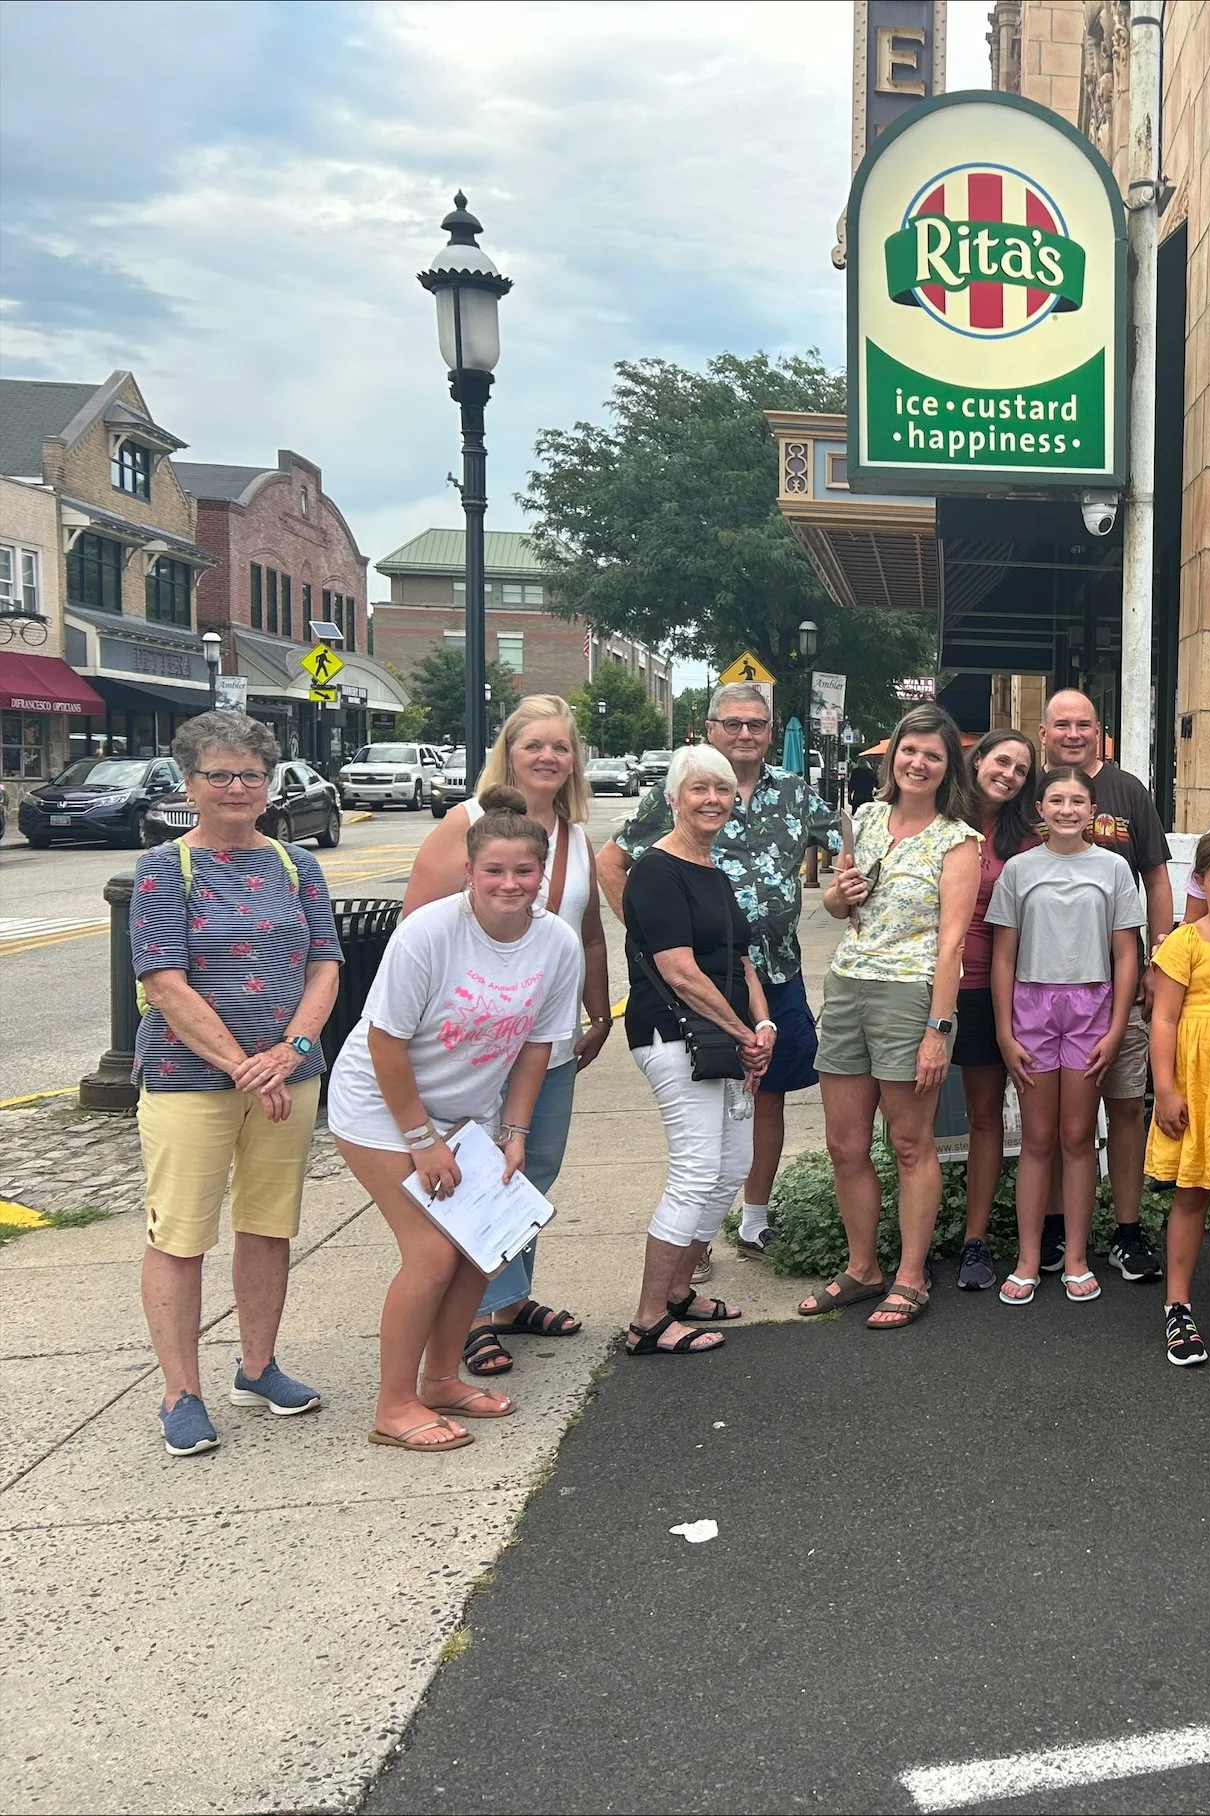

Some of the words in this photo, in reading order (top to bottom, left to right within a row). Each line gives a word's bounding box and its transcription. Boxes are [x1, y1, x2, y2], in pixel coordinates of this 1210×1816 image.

[914, 217, 1065, 287] Rita's
[896, 388, 939, 416] ice
[961, 394, 1077, 422] custard
[908, 421, 1067, 458] happiness
[216, 680, 246, 690] Ambler
[813, 679, 844, 690] Ambler
[53, 702, 81, 712] OPTICIANS
[488, 982, 518, 991] Annual
[521, 970, 545, 989] UDHS
